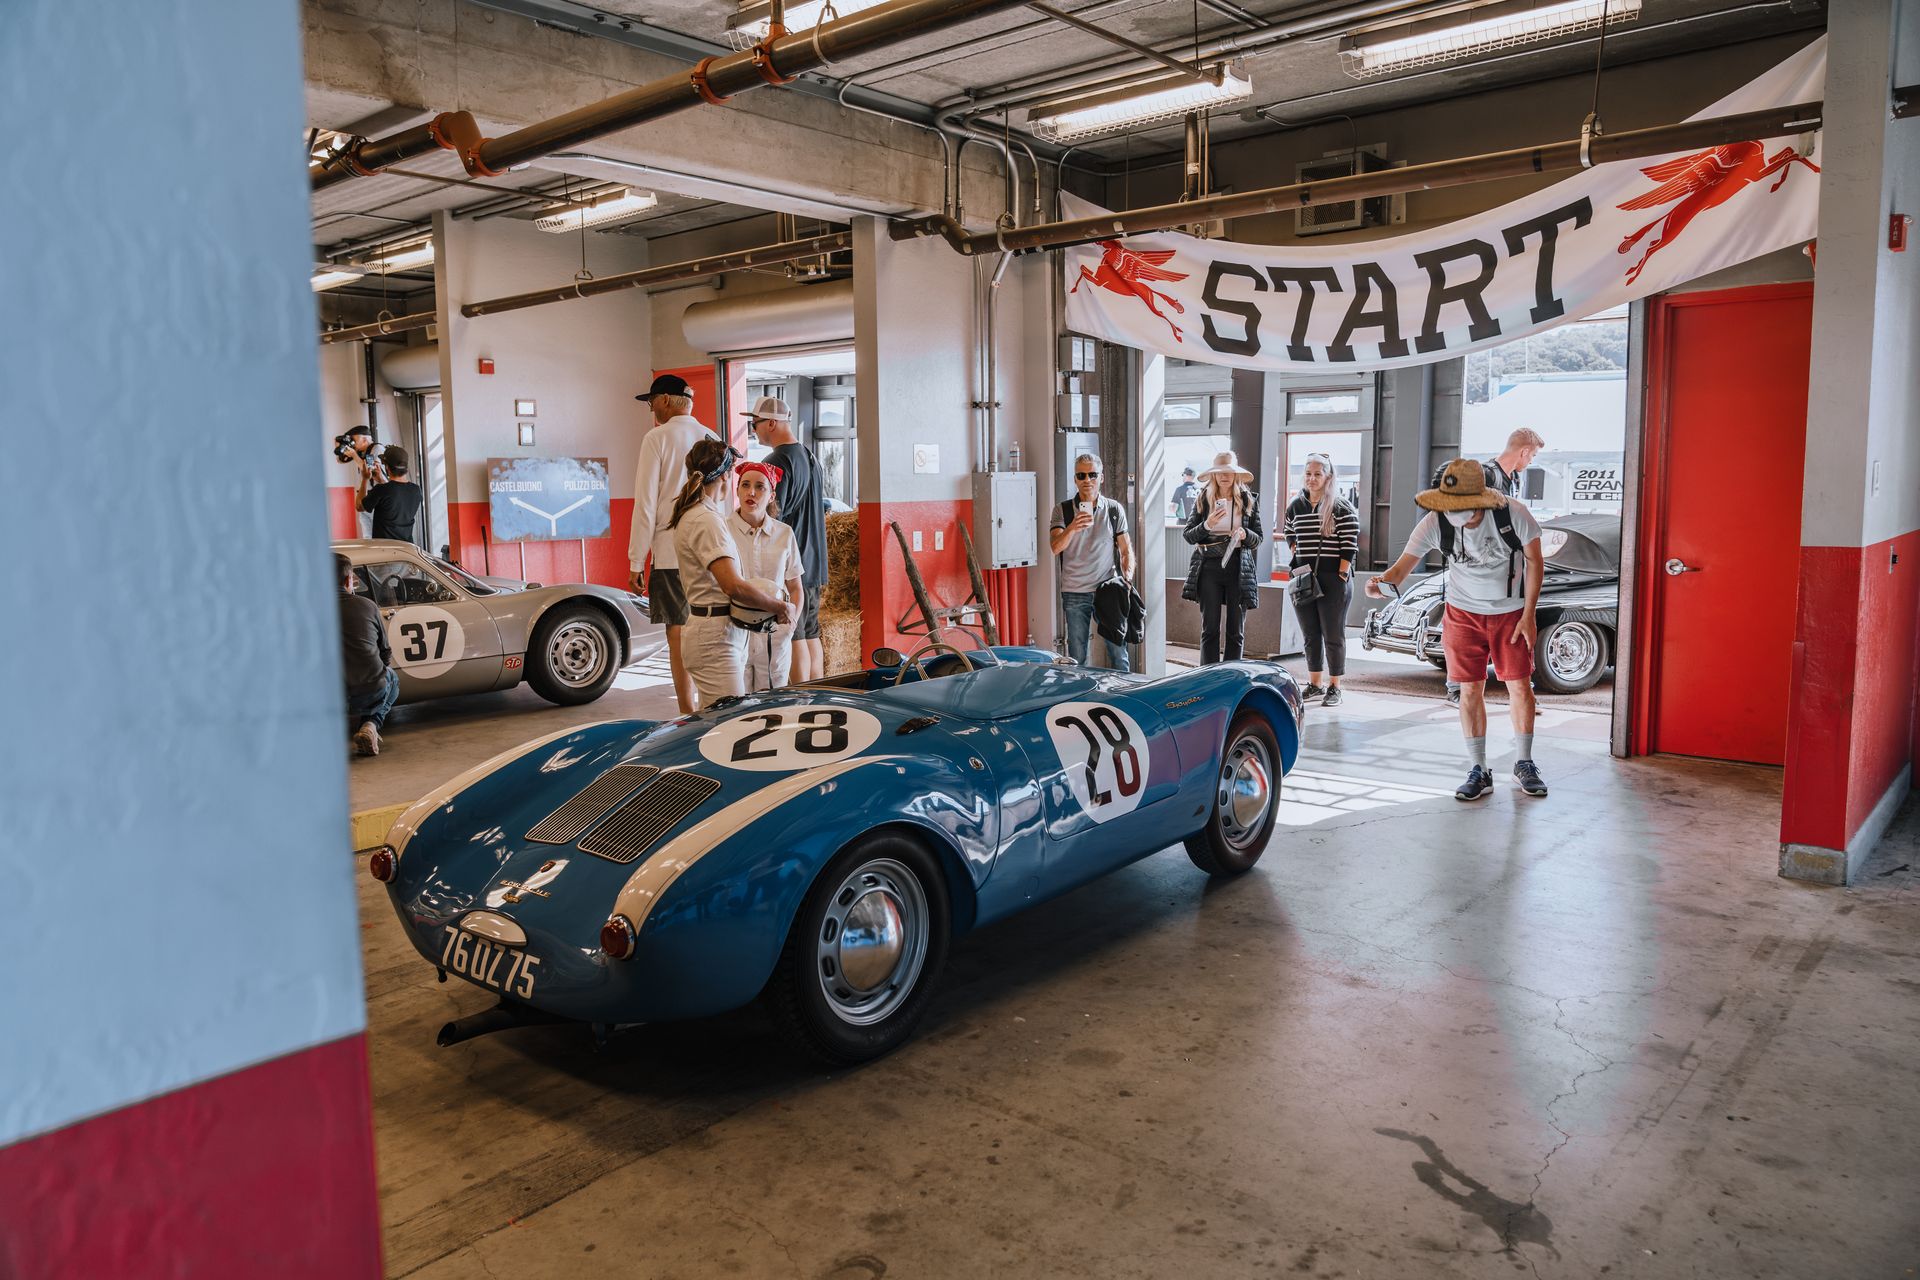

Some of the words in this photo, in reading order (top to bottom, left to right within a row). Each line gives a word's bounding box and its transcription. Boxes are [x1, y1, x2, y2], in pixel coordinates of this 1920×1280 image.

[1201, 195, 1593, 363] START
[489, 481, 543, 492] CASTELBUONO
[563, 480, 590, 491] POLIZZI
[591, 480, 607, 490] GEN.
[1576, 469, 1616, 479] 2011
[1574, 492, 1595, 500] GT
[400, 620, 448, 662] 37
[505, 657, 522, 669] STP
[731, 709, 849, 762] 28
[1055, 707, 1141, 807] 28
[442, 925, 540, 999] 76DZ75
